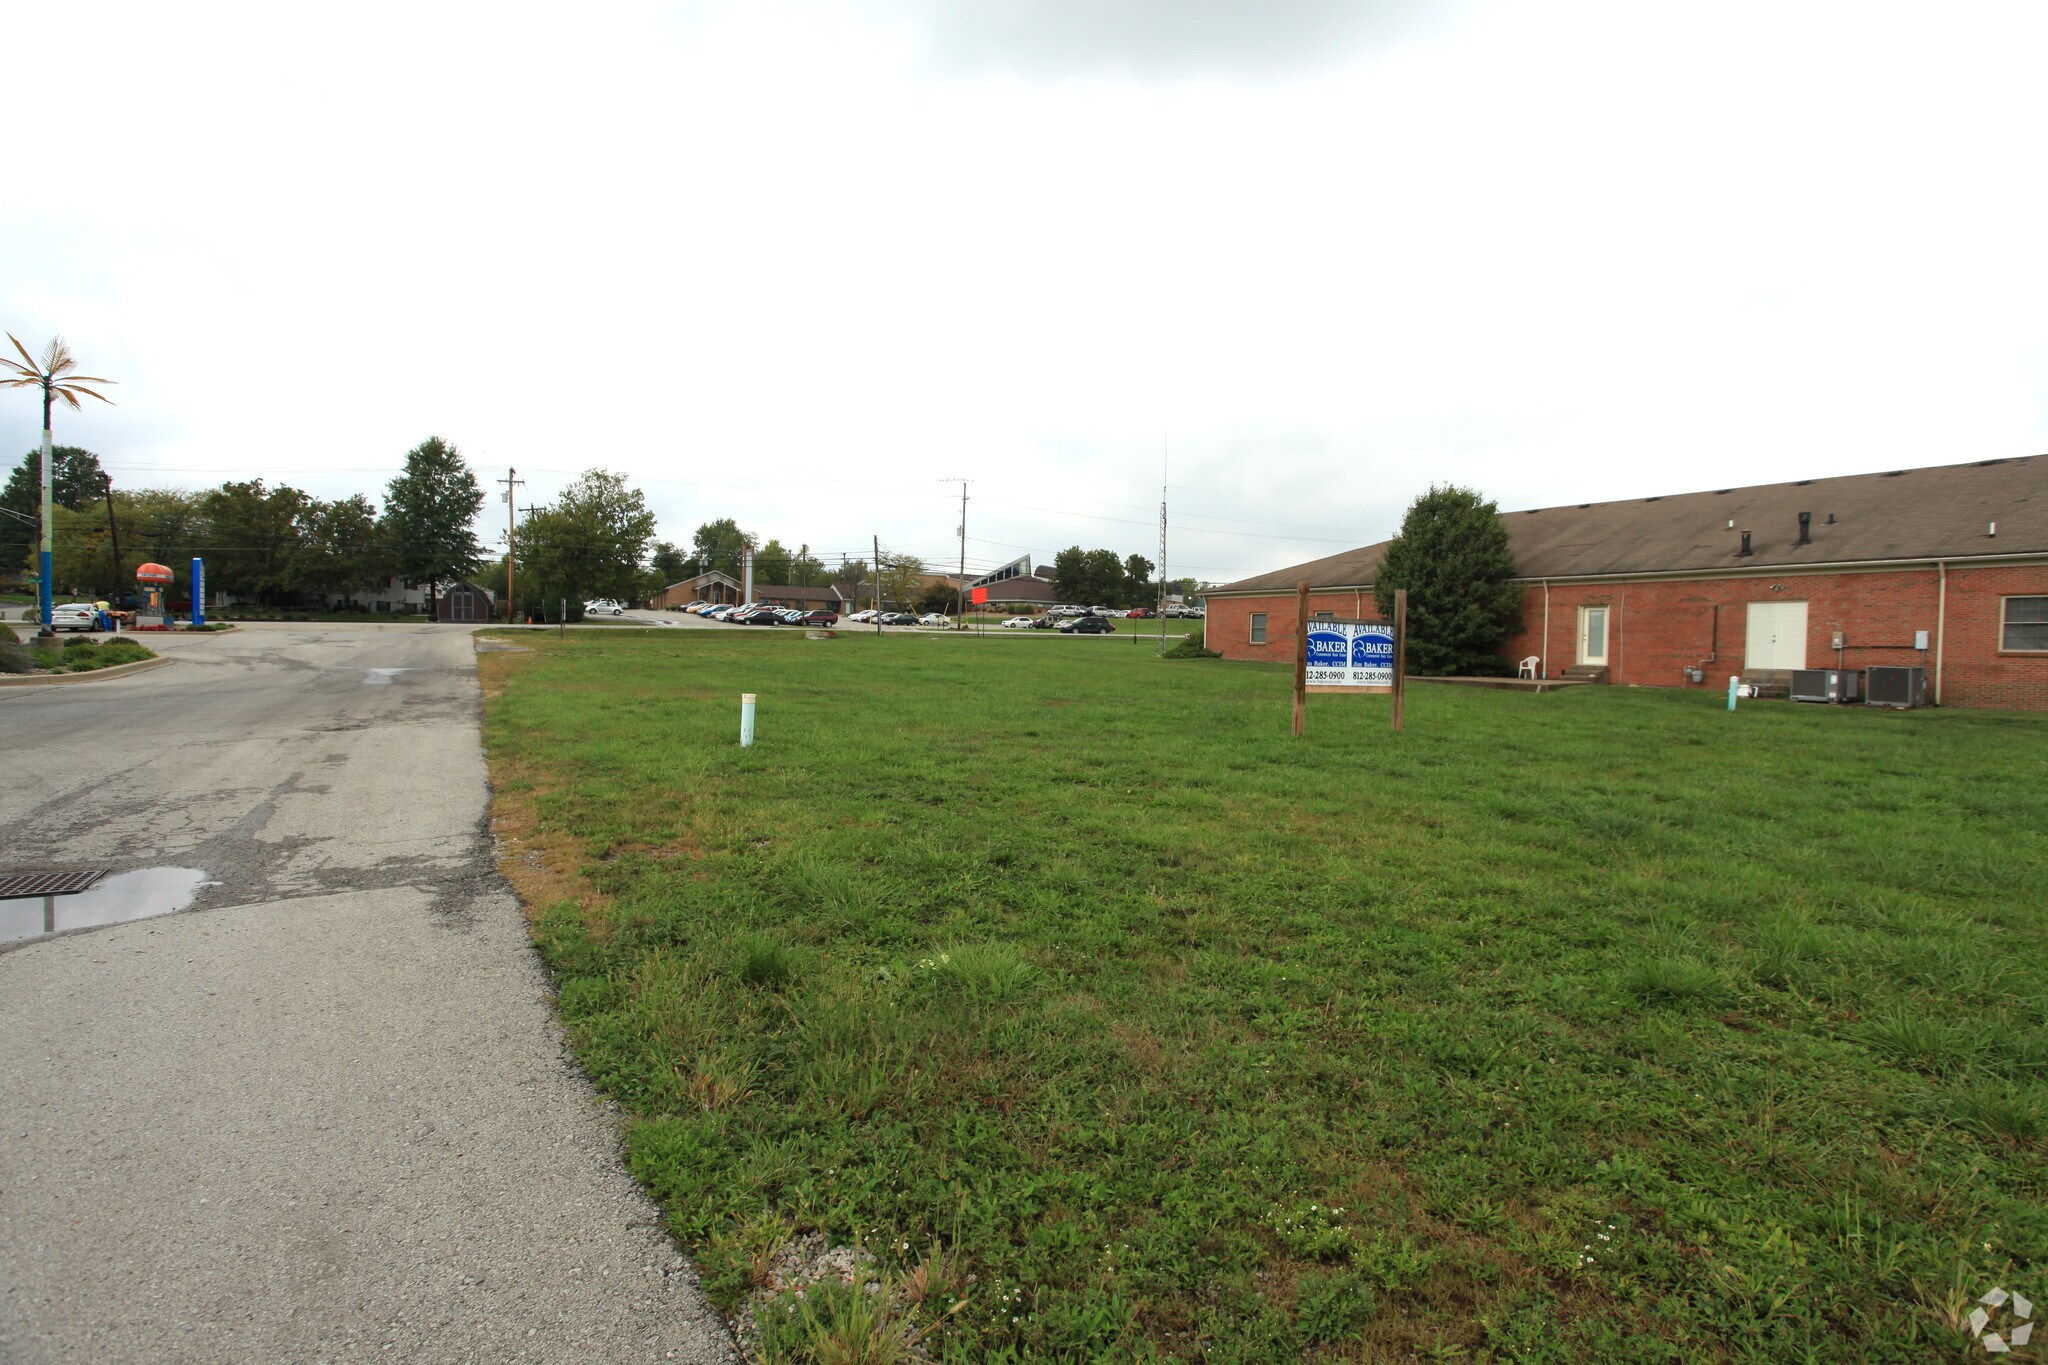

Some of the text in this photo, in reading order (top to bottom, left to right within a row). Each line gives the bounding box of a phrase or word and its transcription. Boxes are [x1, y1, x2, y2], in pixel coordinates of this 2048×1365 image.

[1308, 622, 1347, 636] VAILABLE
[1316, 641, 1346, 652] BAKER
[1366, 643, 1393, 654] BAKER
[1306, 671, 1345, 680] 12-285-0900
[1352, 672, 1392, 680] 812-285-0900
